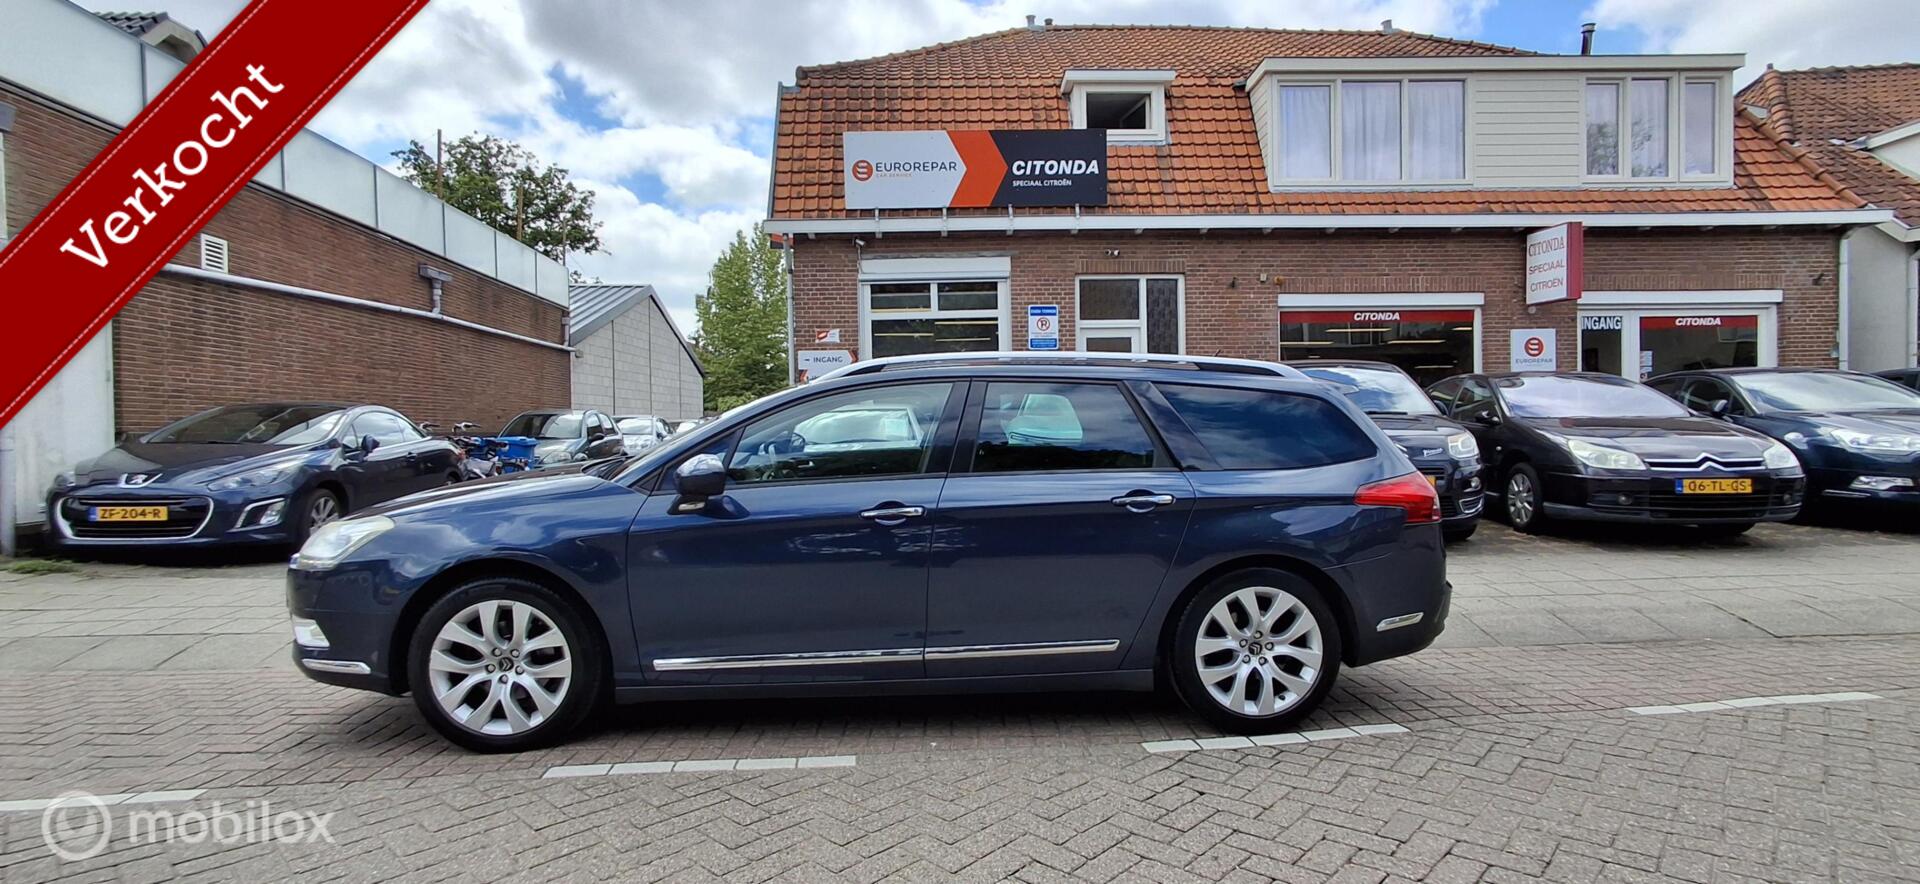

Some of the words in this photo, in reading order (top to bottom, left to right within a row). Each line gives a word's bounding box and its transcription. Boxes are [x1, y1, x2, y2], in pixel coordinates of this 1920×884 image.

[875, 161, 957, 172] EUROREPAR
[1012, 159, 1100, 175] CITONDA
[1043, 178, 1072, 187] CITROËN
[1528, 235, 1565, 257] CITONDA
[1528, 259, 1566, 275] SPECIAAL
[1353, 311, 1401, 321] CITONDA
[1675, 317, 1722, 326] CITONDA
[1581, 316, 1622, 330] INGANG
[1688, 480, 1747, 492] 06-TL-GS
[100, 508, 161, 519] ZF-204-R
